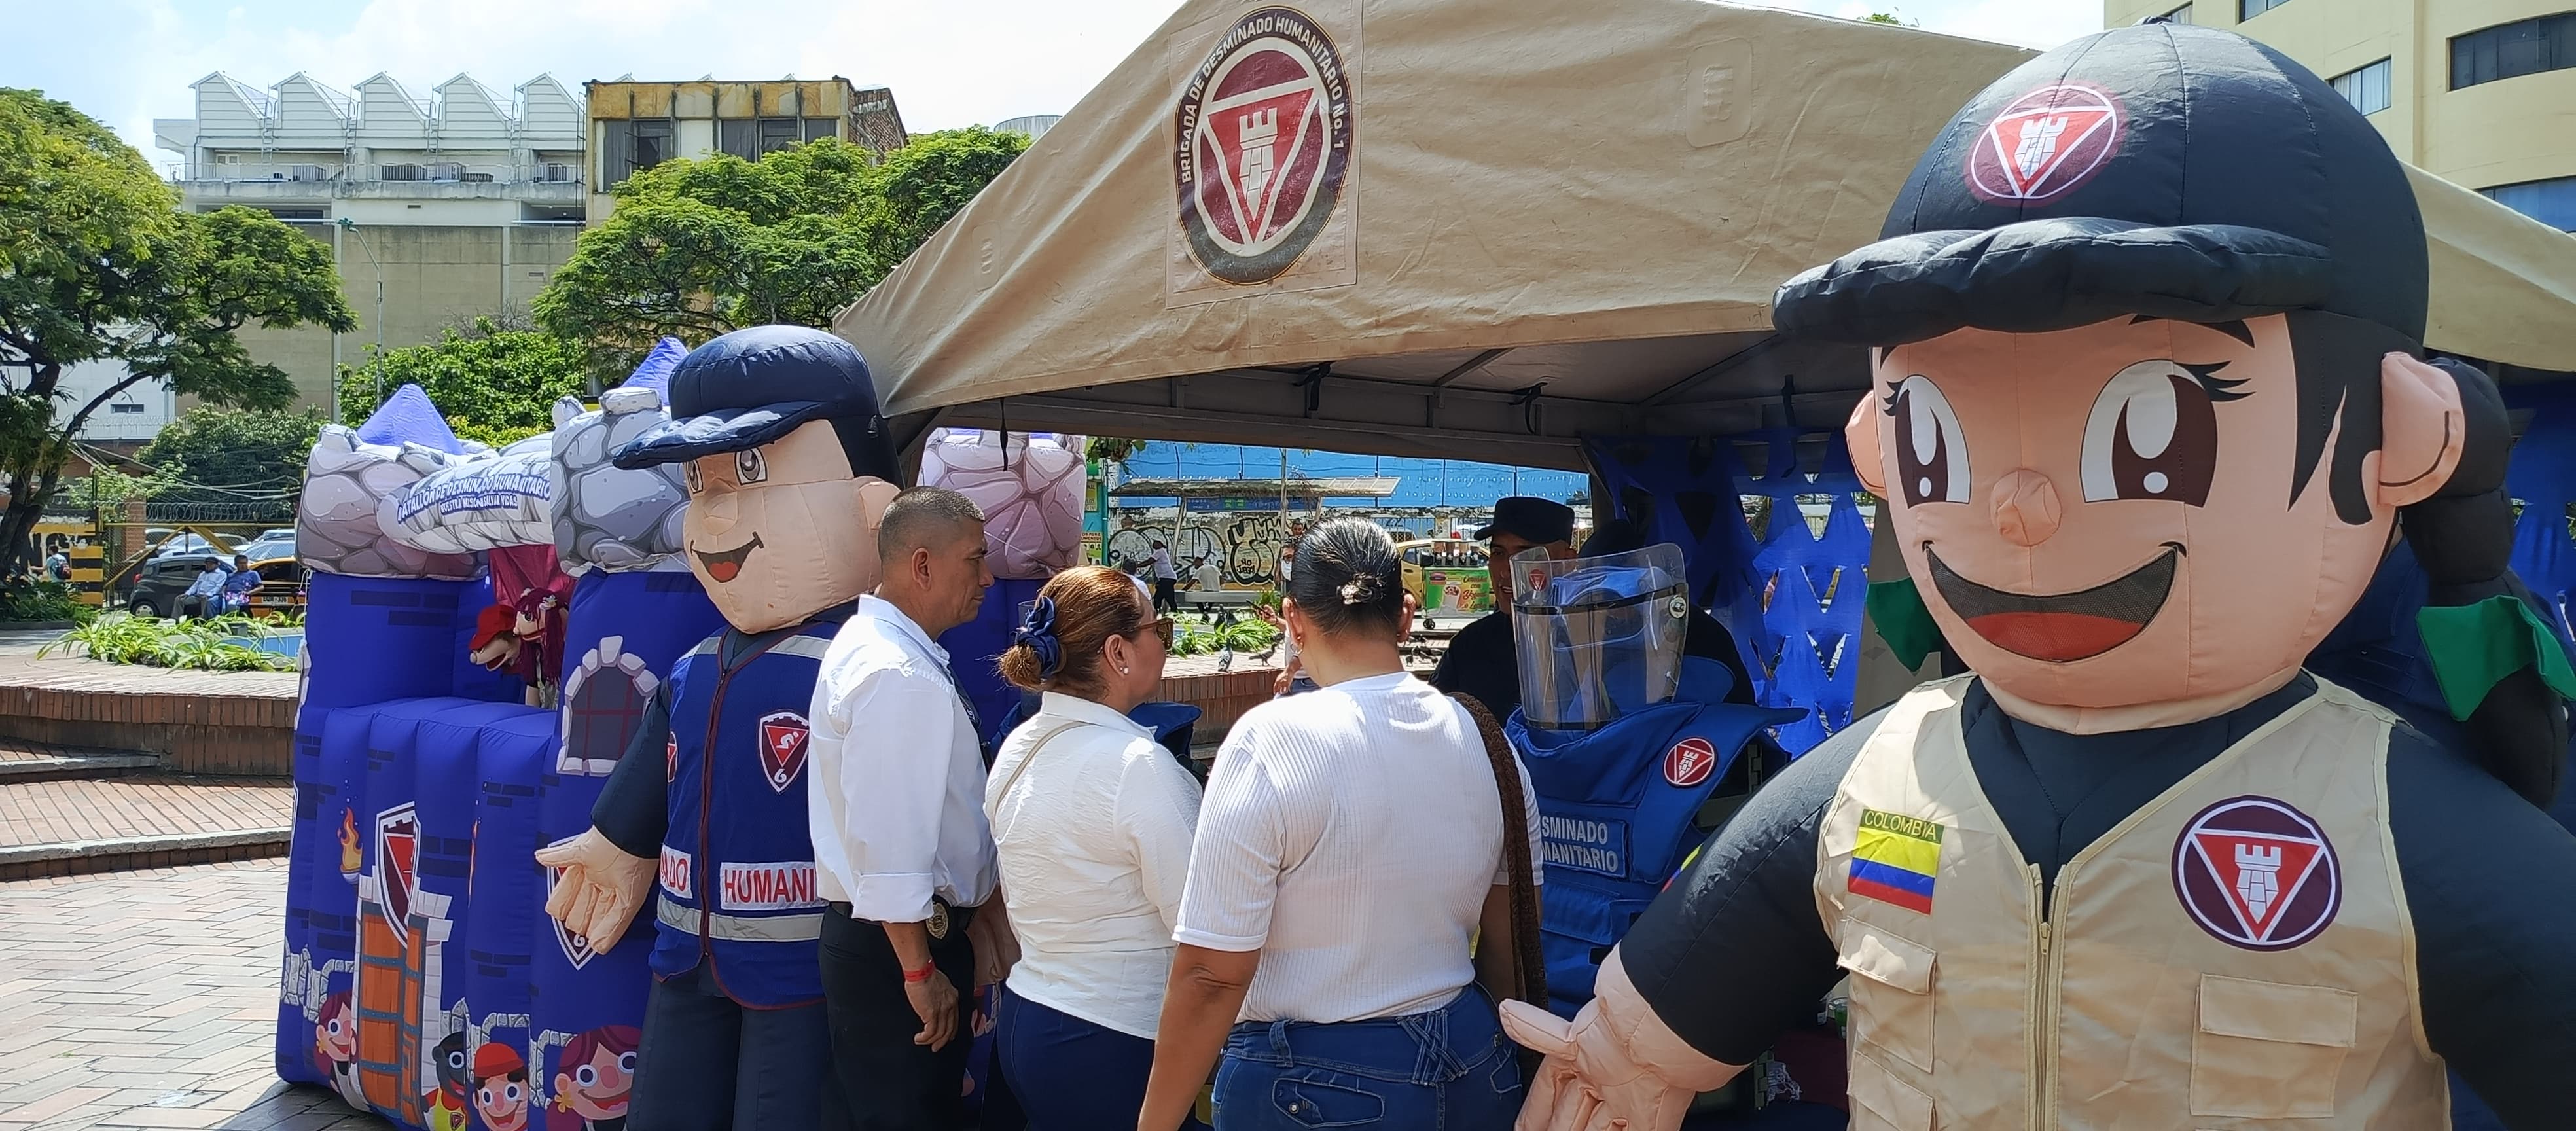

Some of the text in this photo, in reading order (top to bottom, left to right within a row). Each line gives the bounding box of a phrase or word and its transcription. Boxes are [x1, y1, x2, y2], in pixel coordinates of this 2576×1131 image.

[1180, 16, 1345, 183] BRIGADA DE DESMINADO HUMANITARIO No. 1
[774, 768, 787, 783] 6
[1541, 815, 1608, 845] SMINADO
[724, 868, 816, 903] HUMANI
